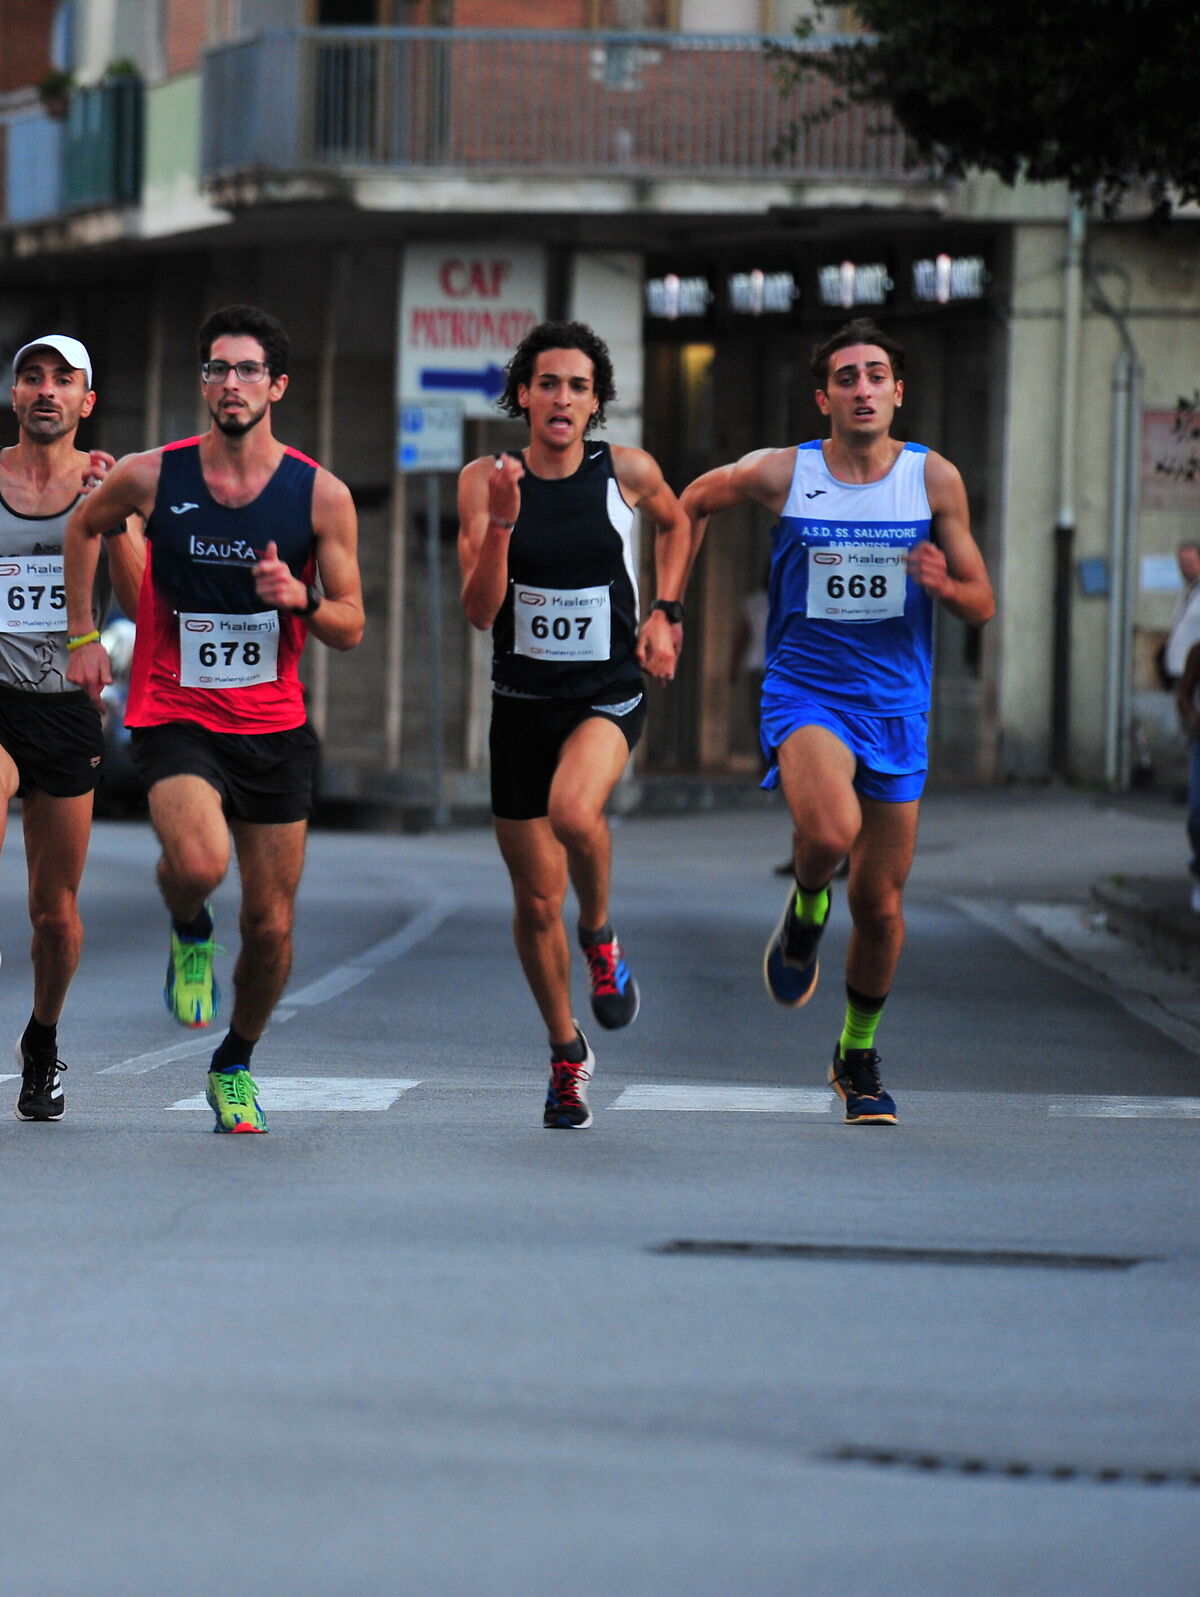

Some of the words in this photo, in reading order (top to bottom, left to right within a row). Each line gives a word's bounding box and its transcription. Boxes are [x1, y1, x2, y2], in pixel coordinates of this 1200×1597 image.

[802, 527, 832, 537] A.S.D.
[836, 528, 851, 538] SS.
[854, 528, 917, 538] SALVATORE
[27, 564, 63, 574] Kale
[827, 575, 887, 599] 668
[8, 585, 66, 611] 675
[552, 597, 606, 608] Kalenji
[220, 619, 276, 632] Kalenji
[532, 616, 593, 640] 607
[200, 641, 261, 668] 678
